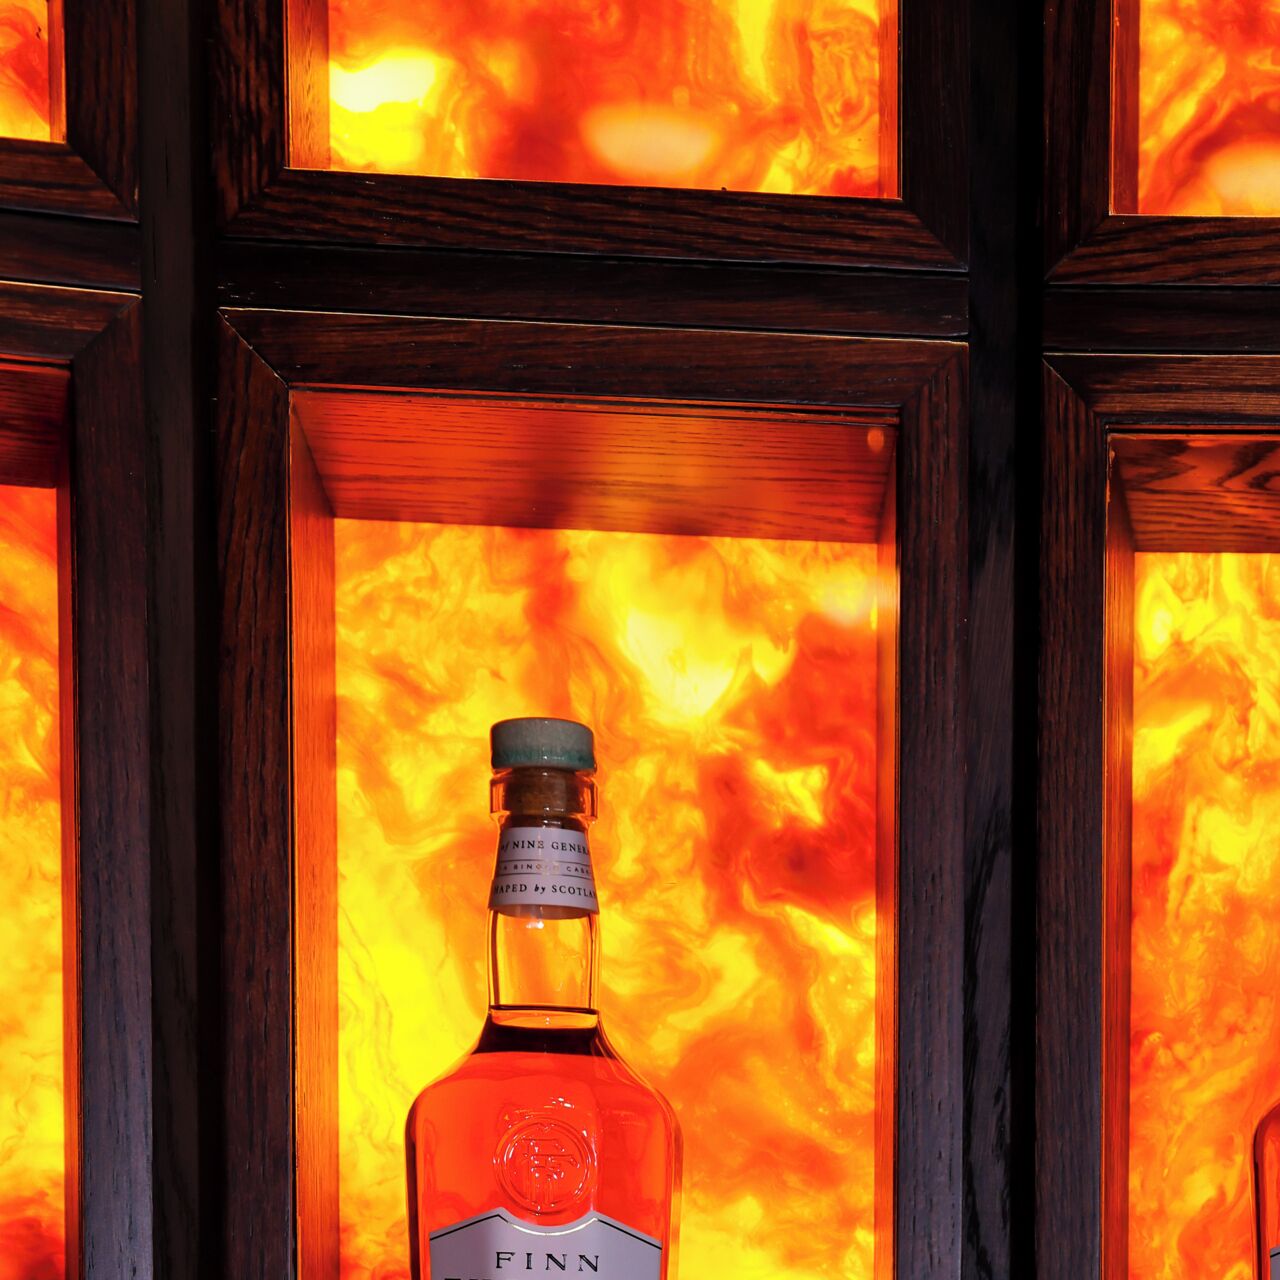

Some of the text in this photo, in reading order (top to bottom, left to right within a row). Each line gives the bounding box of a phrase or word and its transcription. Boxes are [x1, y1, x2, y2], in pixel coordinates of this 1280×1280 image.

[512, 840, 545, 849] NINE
[534, 884, 546, 894] by
[496, 1251, 600, 1272] FINN
